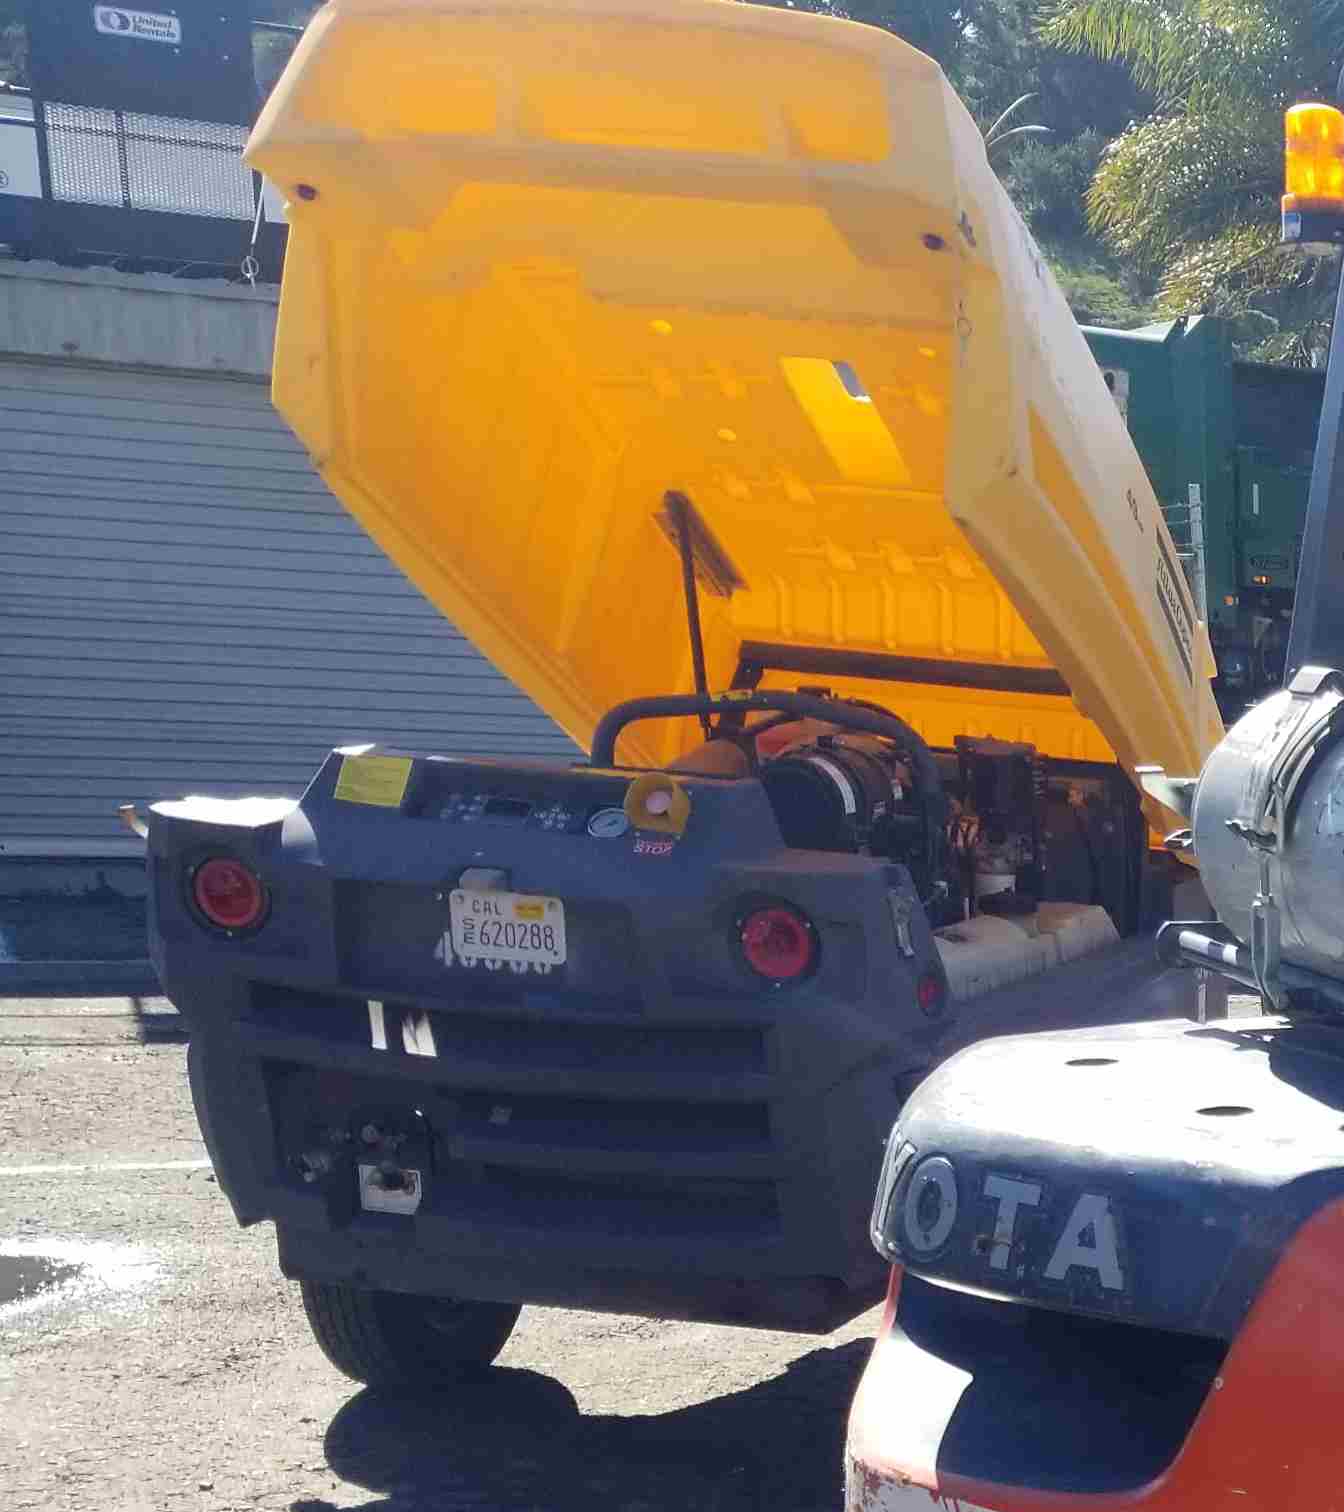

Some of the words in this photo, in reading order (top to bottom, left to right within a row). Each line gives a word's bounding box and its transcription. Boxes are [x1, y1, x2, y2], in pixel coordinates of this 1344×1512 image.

[131, 14, 173, 29] United
[131, 24, 177, 40] Rentals
[472, 899, 503, 917] CAL
[480, 919, 555, 952] 620288
